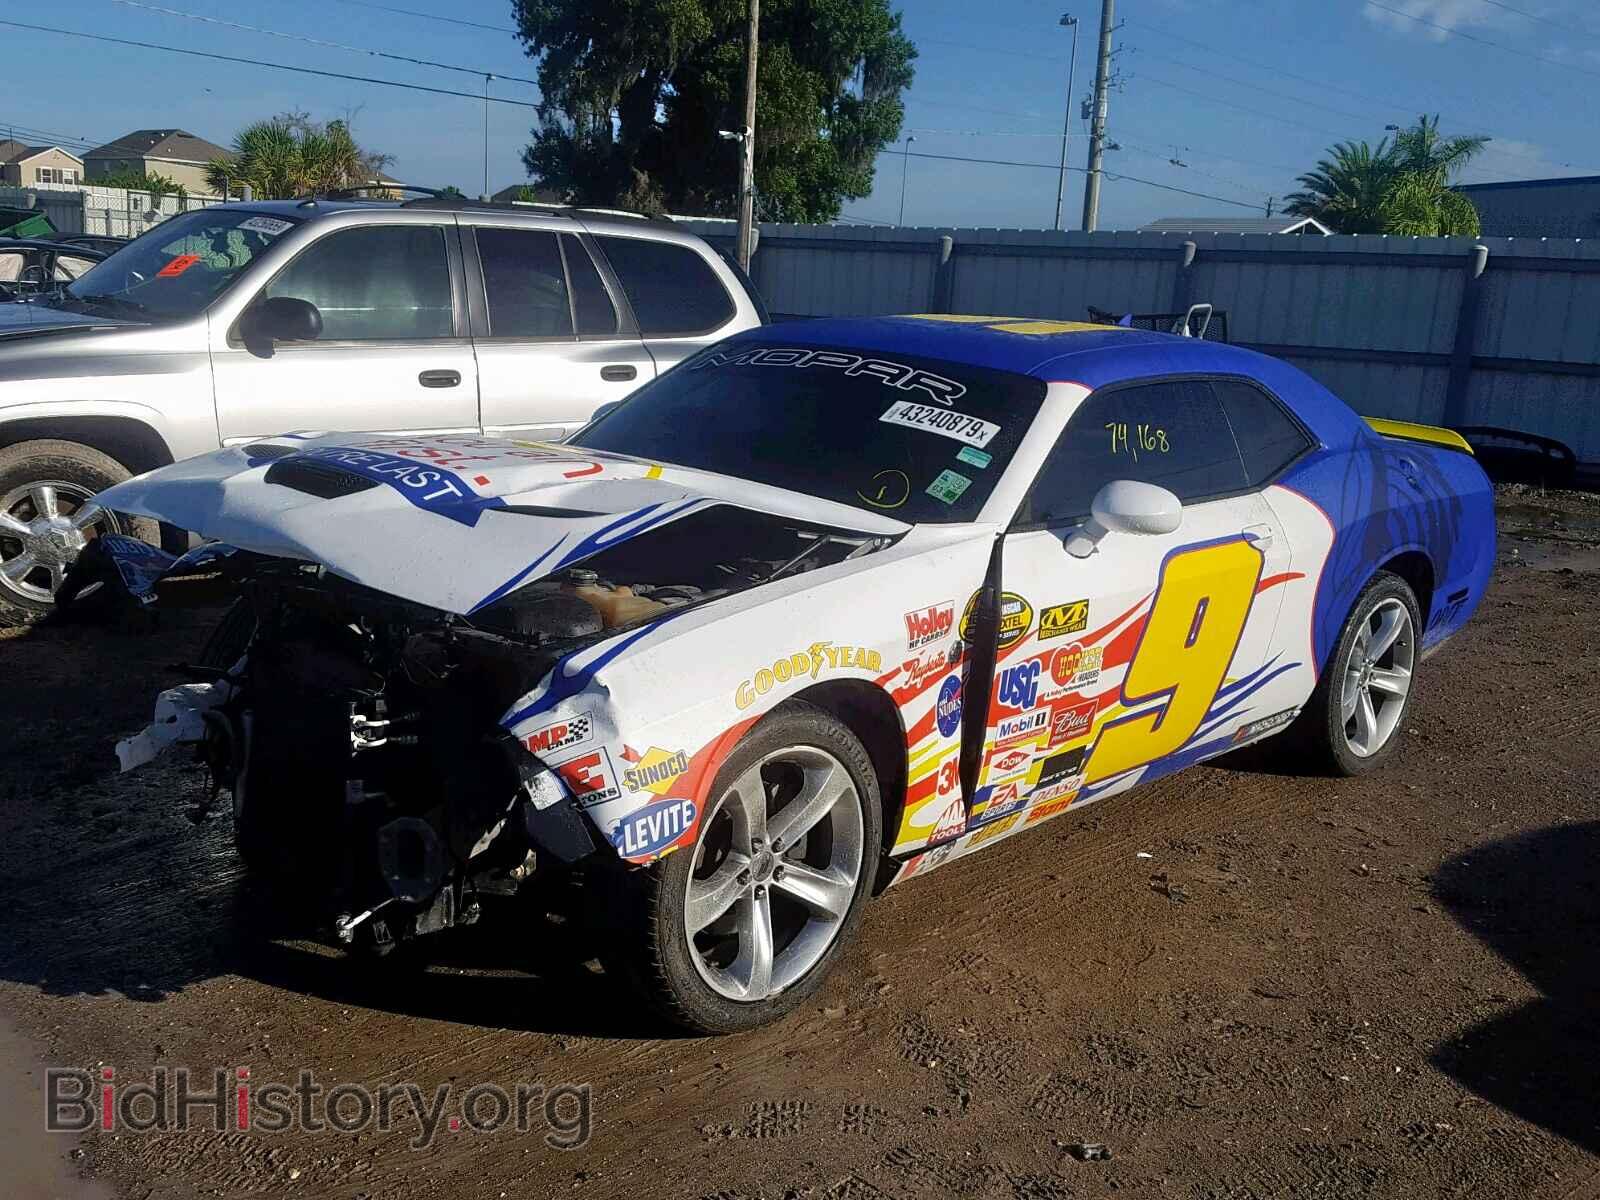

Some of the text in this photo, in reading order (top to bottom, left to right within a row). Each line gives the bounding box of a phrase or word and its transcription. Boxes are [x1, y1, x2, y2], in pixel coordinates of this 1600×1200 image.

[696, 348, 967, 406] MOPAR
[899, 404, 984, 437] 43240879
[1104, 422, 1170, 463] 74,168
[367, 459, 464, 501] LAST
[905, 607, 954, 641] Holley
[734, 640, 883, 710] GOODYEAR
[1057, 645, 1103, 679] HOOKER
[1084, 533, 1265, 786] 9
[999, 660, 1040, 709] USG
[999, 714, 1034, 739] Mobil
[1034, 711, 1047, 727] 1
[1055, 704, 1095, 736] Bud
[547, 733, 583, 751] CAMS
[623, 749, 689, 794] SUNOCO
